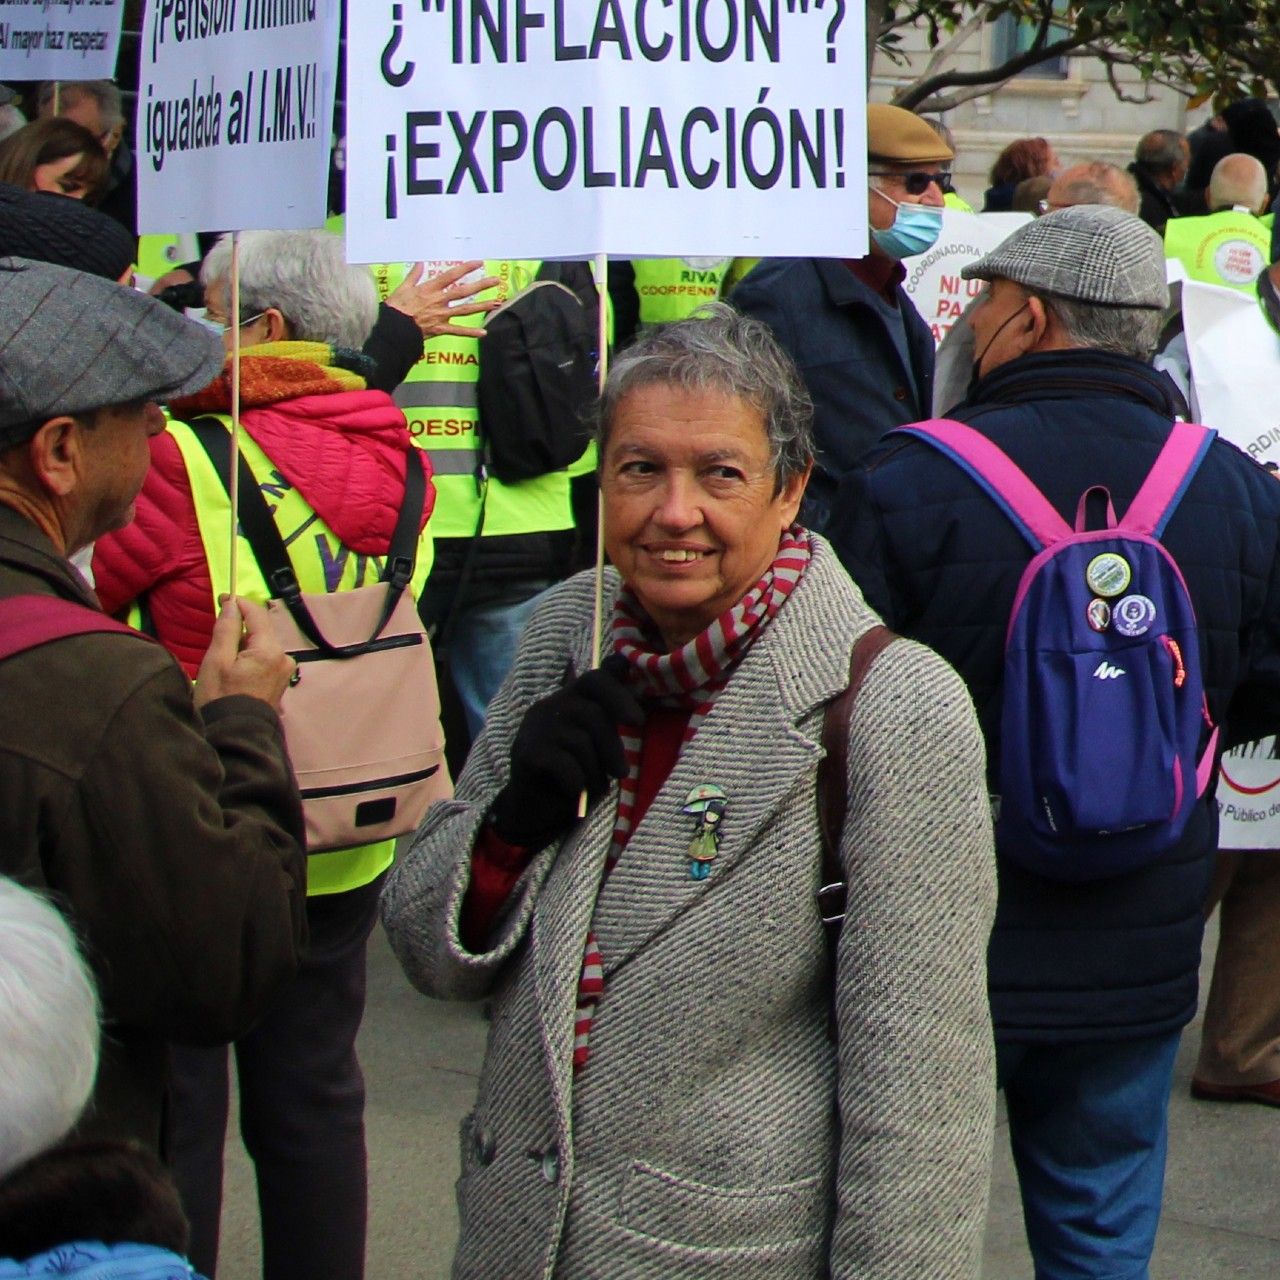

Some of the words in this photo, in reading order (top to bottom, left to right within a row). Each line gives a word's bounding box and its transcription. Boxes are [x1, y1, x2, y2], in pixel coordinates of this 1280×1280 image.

[11, 30, 43, 59] mayor
[44, 22, 65, 50] haz
[146, 75, 222, 172] igualada
[227, 70, 254, 145] al
[258, 63, 318, 143] I.M.V.!
[386, 87, 846, 219] ¡EXPOLIACIÓN!
[681, 270, 722, 283] RIVA
[906, 243, 981, 294] COORDINADORA
[939, 275, 960, 295] NI
[965, 278, 981, 298] U
[936, 299, 961, 319] PA
[1224, 803, 1266, 823] Público
